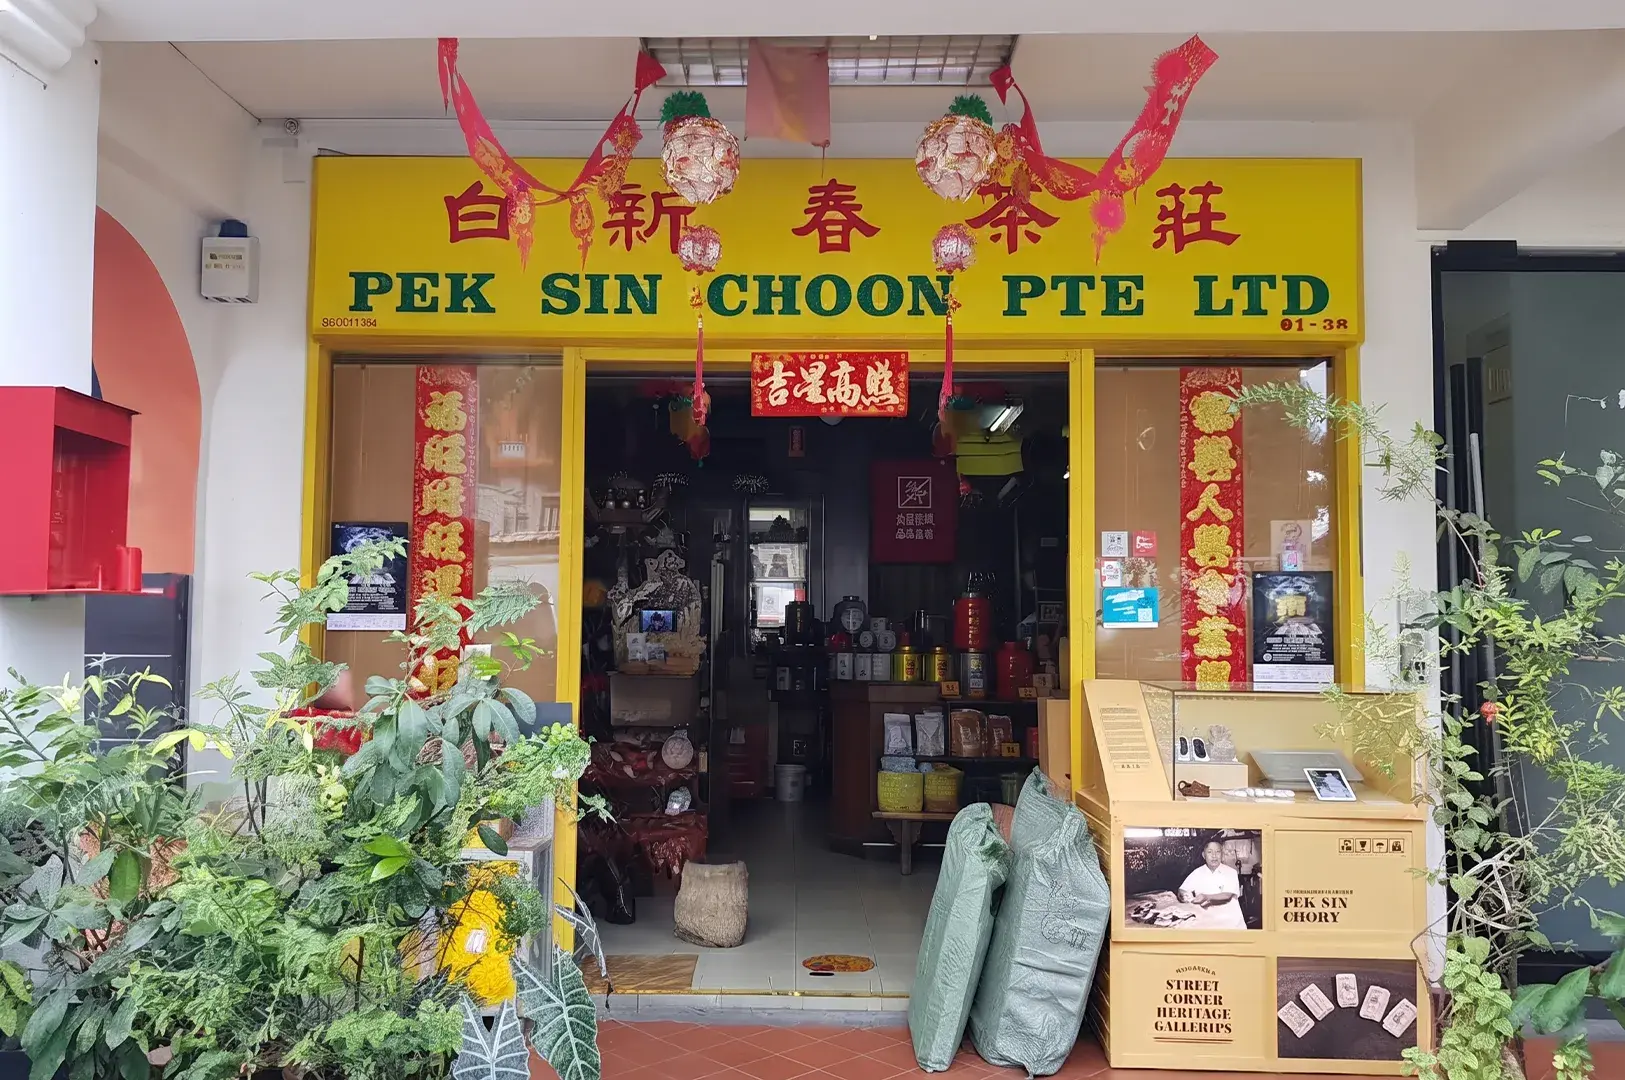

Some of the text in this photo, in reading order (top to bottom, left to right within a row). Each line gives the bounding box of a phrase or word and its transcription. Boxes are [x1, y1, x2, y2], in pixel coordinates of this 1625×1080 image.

[349, 271, 1330, 317] PEK SIN CHOON PTE LTD
[758, 358, 901, 408] 吉星高照
[1283, 896, 1348, 909] PEK SIN
[1165, 979, 1220, 992] STREET
[1163, 993, 1223, 1006] CORNER
[1157, 1007, 1232, 1020] HERITAGE
